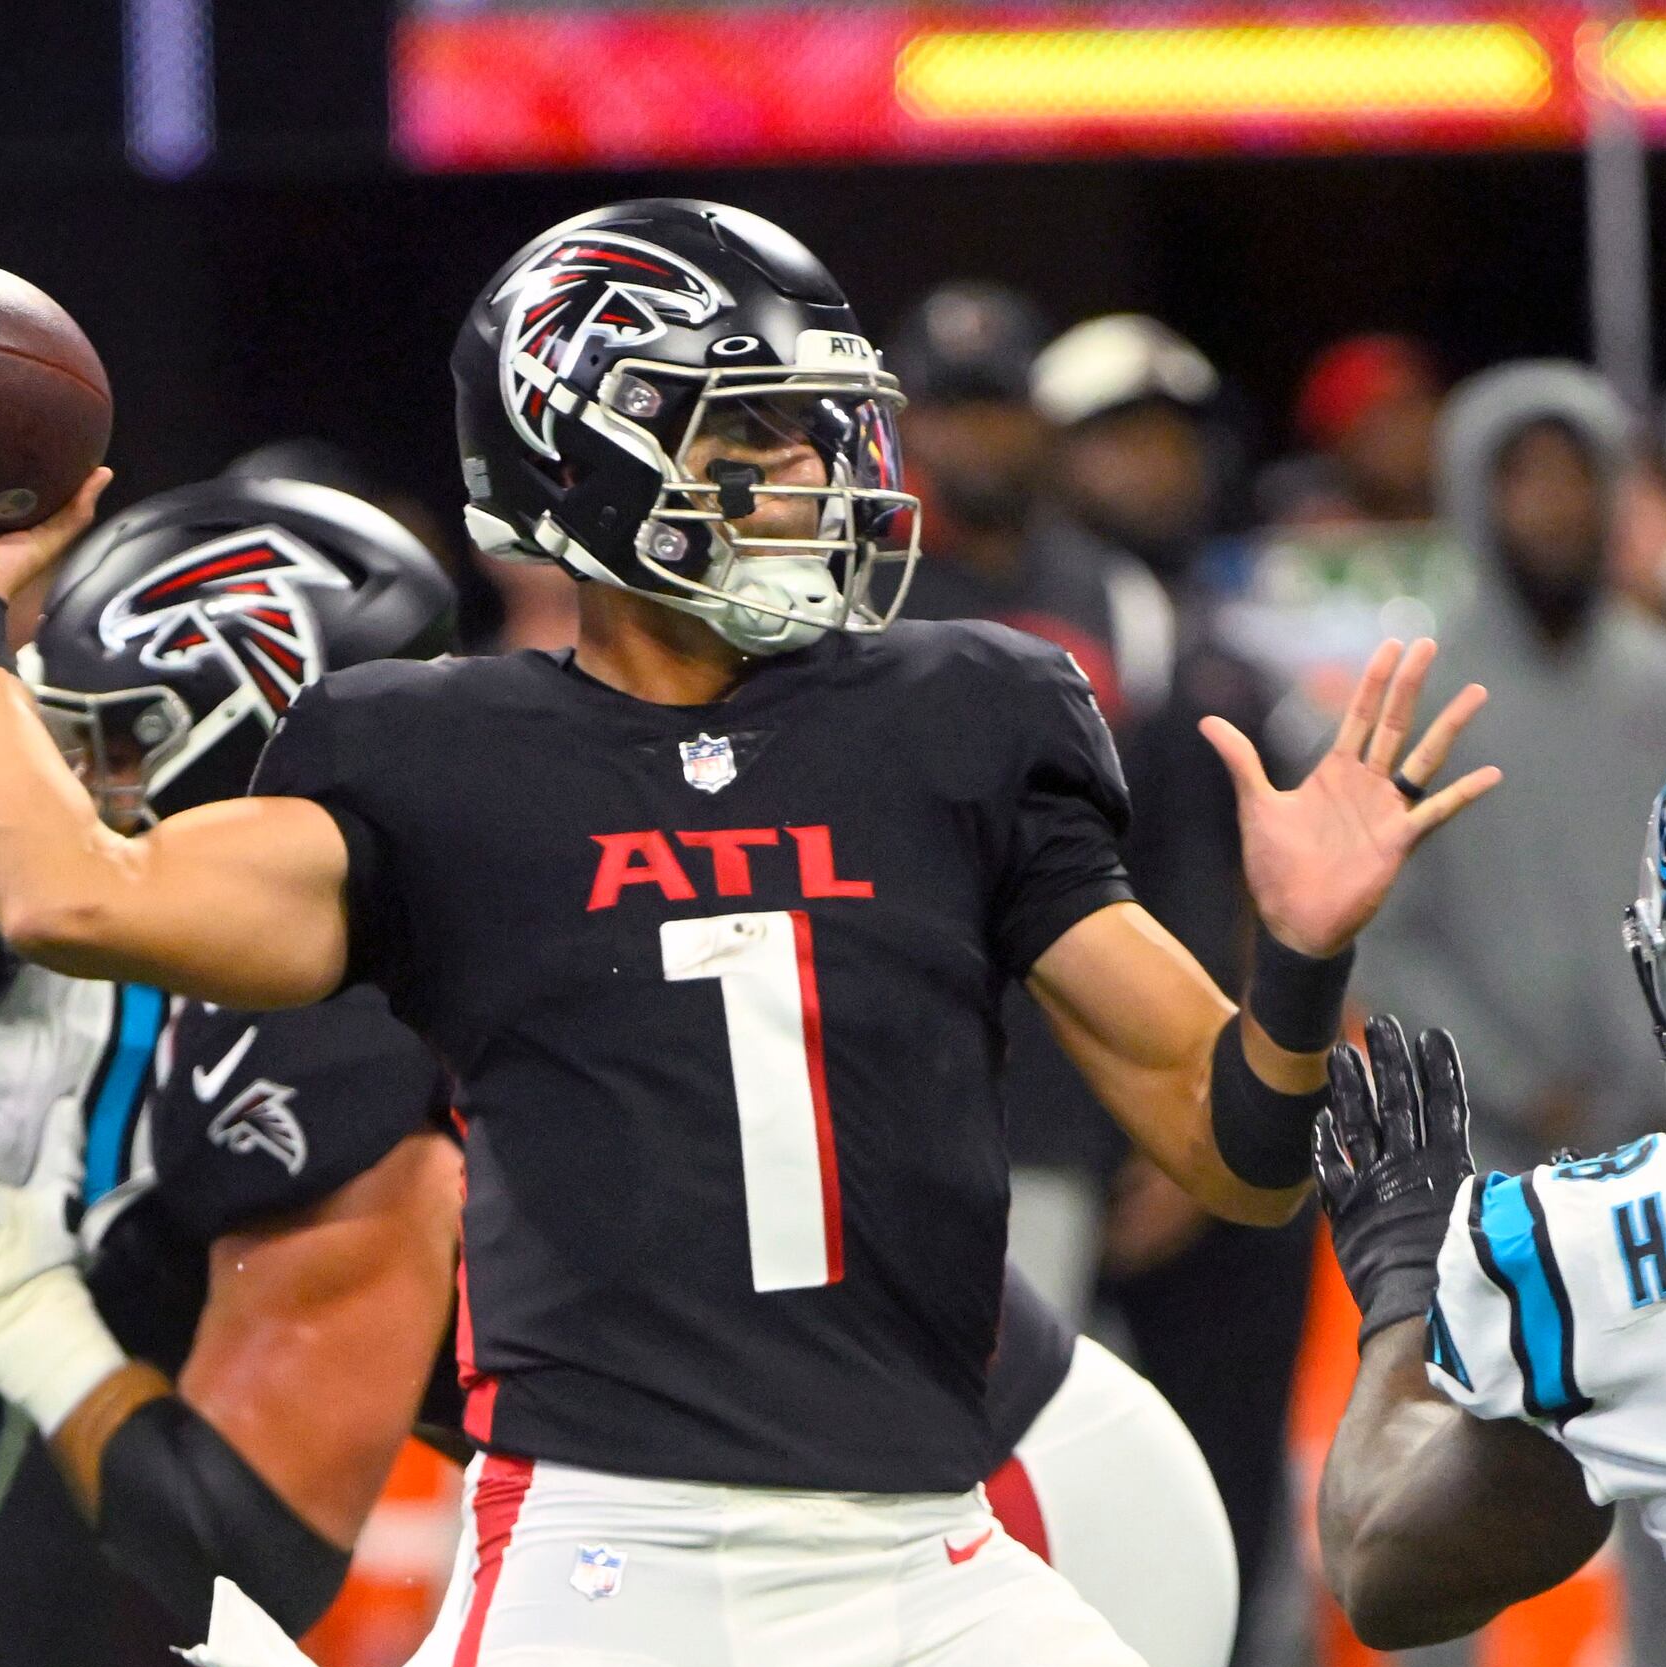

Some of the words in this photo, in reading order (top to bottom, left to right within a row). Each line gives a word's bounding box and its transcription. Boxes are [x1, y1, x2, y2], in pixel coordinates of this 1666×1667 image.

[830, 336, 868, 357] ATL
[586, 825, 876, 911] ATL
[659, 909, 846, 1293] 1
